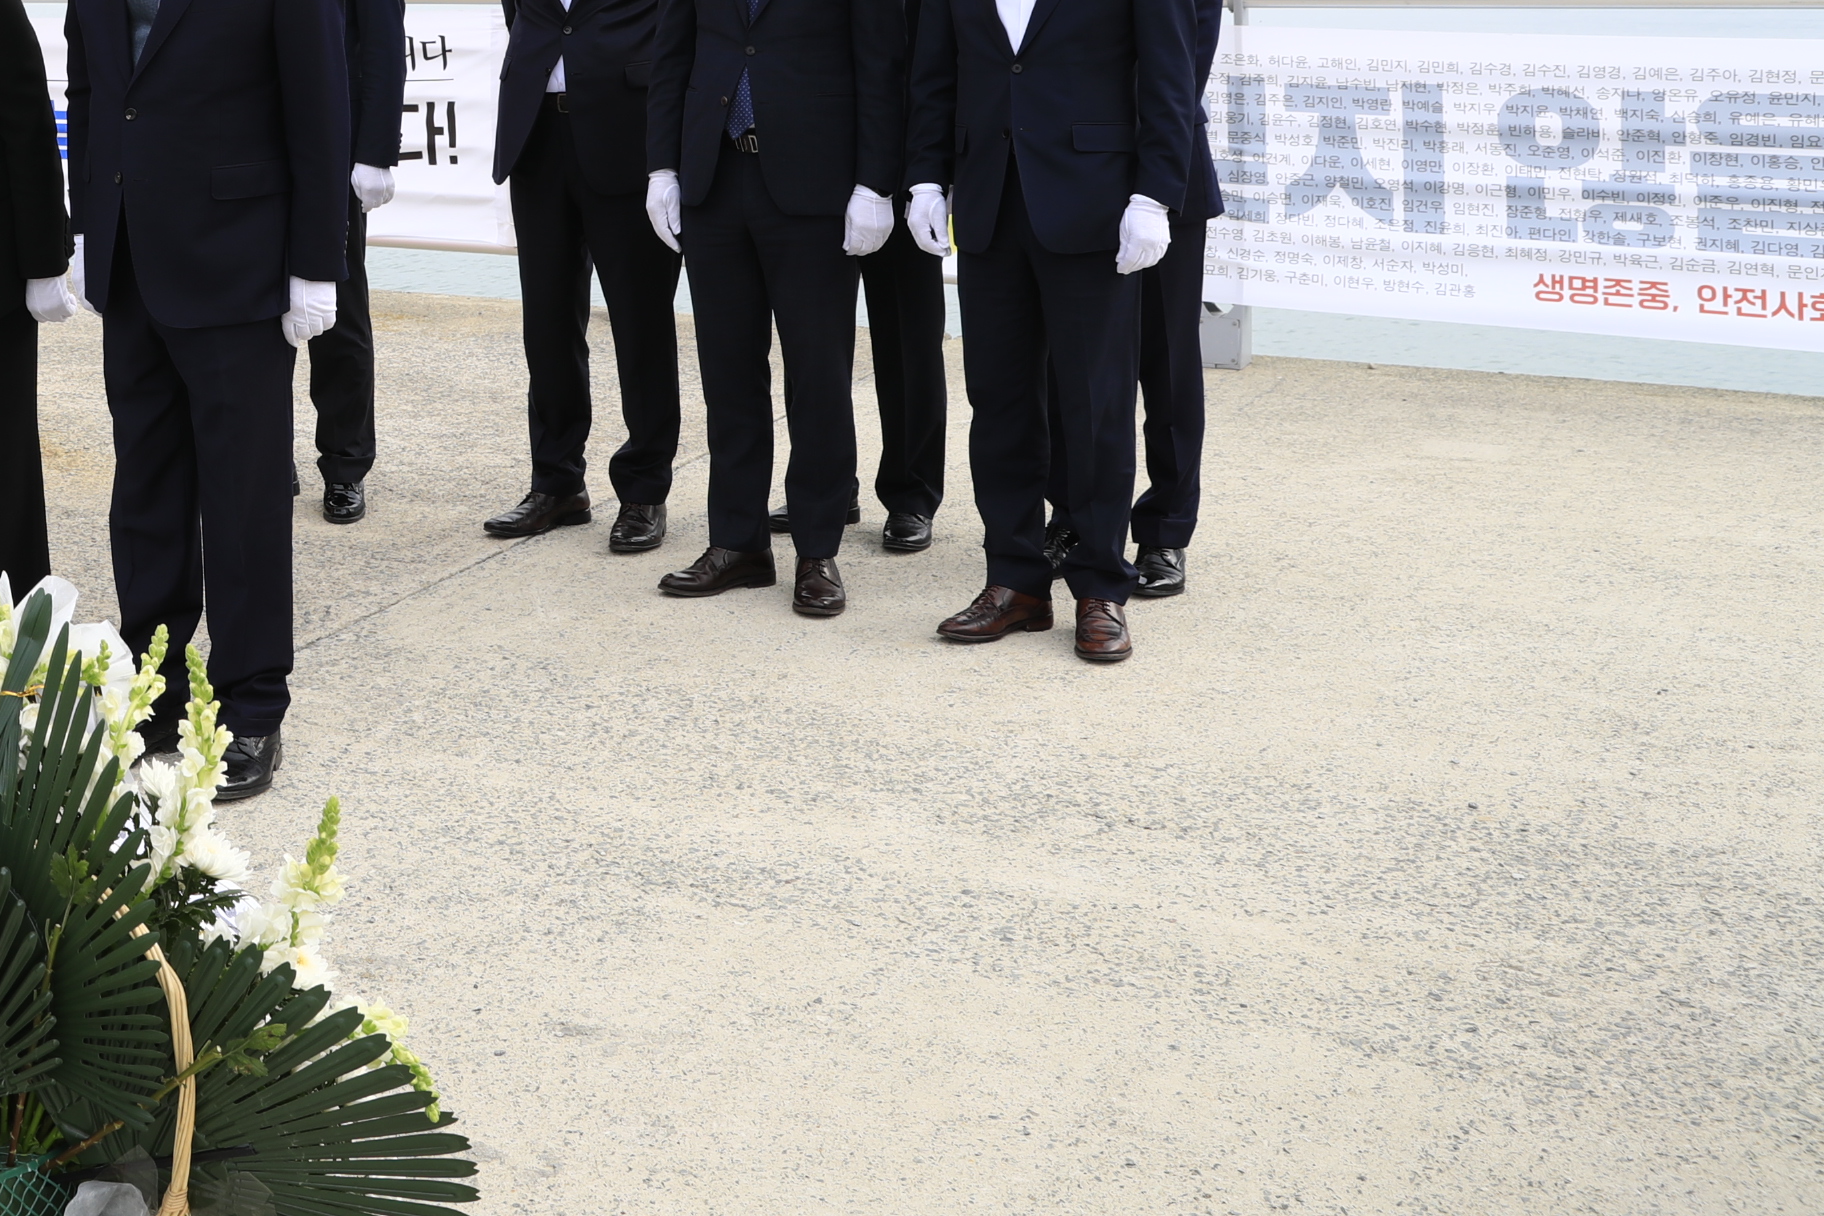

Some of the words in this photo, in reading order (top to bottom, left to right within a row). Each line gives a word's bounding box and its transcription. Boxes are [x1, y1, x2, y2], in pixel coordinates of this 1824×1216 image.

[1219, 51, 1263, 69] 조은화,
[1267, 53, 1311, 71] 허다윤,
[1316, 55, 1361, 73] 고해인,
[1366, 57, 1412, 75] 김민지,
[1416, 59, 1464, 77] 김민희,
[1468, 61, 1517, 78] 김수경,
[1521, 63, 1571, 80] 김수진,
[1576, 64, 1626, 82] 김영경,
[1631, 66, 1683, 83] 김예은,
[1688, 67, 1742, 84] 김주아,
[1747, 69, 1802, 86] 김현정,
[1206, 89, 1250, 107] 김영은,
[1253, 91, 1298, 109] 김주은,
[1302, 93, 1347, 111] 김지인,
[1351, 95, 1397, 113] 박영란,
[1401, 97, 1448, 115] 박예슬,
[1453, 99, 1501, 117] 박지우,
[1505, 101, 1553, 119] 박지윤,
[1613, 106, 1664, 124] 백지숙,
[1670, 108, 1722, 126] 신승희,
[1727, 110, 1781, 128] 유예은,
[1208, 71, 1235, 88] 수정,
[1238, 72, 1283, 90] 김주희,
[1286, 75, 1331, 92] 김지윤,
[1335, 77, 1381, 94] 남수빈,
[1436, 80, 1483, 98] 박정은,
[1488, 82, 1536, 100] 박주희,
[1595, 86, 1646, 103] 송지나,
[1651, 87, 1702, 105] 양온유,
[1707, 89, 1761, 106] 오유정,
[1766, 90, 1821, 108] 윤민지,
[1208, 109, 1254, 127] 김웅기,
[1257, 111, 1301, 129] 김윤수,
[1306, 114, 1351, 132] 김정현,
[1355, 116, 1401, 134] 김호연,
[1405, 118, 1452, 136] 박수현,
[1507, 123, 1556, 141] 빈하용,
[1562, 125, 1611, 143] 슬라바,
[1615, 127, 1666, 145] 안준혁,
[1671, 129, 1723, 147] 안형준,
[1728, 131, 1783, 149] 임경빈,
[1227, 130, 1269, 148] 문중식,
[1273, 132, 1318, 150] 박성호,
[1322, 134, 1367, 152] 박준민,
[1372, 136, 1418, 154] 박진리,
[1422, 138, 1469, 156] 박홍래,
[1474, 141, 1522, 159] 서동진,
[1526, 143, 1575, 161] 오준영,
[1580, 145, 1630, 163] 이석준,
[1635, 148, 1686, 166] 이진환,
[1689, 150, 1744, 168] 이창현,
[1750, 153, 1804, 171] 이홍승,
[1251, 150, 1295, 168] 이건계,
[1300, 152, 1345, 170] 이다운,
[1349, 155, 1395, 173] 이세현,
[1401, 157, 1446, 175] 이영만,
[1451, 159, 1498, 178] 이장환,
[1504, 162, 1551, 180] 이태민,
[1557, 164, 1606, 183] 전현탁,
[1668, 170, 1720, 188] 최덕하,
[1227, 168, 1269, 187] 심장영,
[1274, 171, 1319, 190] 안중근,
[1323, 174, 1368, 192] 양철민,
[1372, 177, 1418, 195] 오영석,
[1423, 179, 1470, 198] 이강명,
[1474, 182, 1522, 200] 이근형,
[1527, 185, 1575, 203] 이민우,
[1581, 187, 1630, 206] 이수빈,
[1635, 190, 1687, 208] 이정인,
[1692, 192, 1744, 211] 이준우,
[1750, 195, 1804, 213] 이진형,
[1301, 192, 1345, 210] 이재욱,
[1351, 195, 1395, 213] 이호진,
[1402, 198, 1446, 216] 임건우,
[1452, 201, 1499, 219] 임현진,
[1504, 203, 1553, 222] 장준형,
[1668, 212, 1720, 231] 조봉석,
[1725, 215, 1779, 234] 조찬민,
[1203, 224, 1247, 243] 전수영,
[1252, 227, 1296, 246] 김초원,
[1300, 231, 1345, 250] 이해봉,
[1350, 234, 1395, 253] 남윤철,
[1401, 238, 1447, 257] 이지혜,
[1451, 241, 1499, 261] 김응현,
[1504, 245, 1552, 264] 최혜정,
[1557, 249, 1607, 268] 강민규,
[1612, 252, 1663, 271] 박육근,
[1668, 256, 1721, 275] 김순금,
[1726, 259, 1780, 278] 김연혁,
[1274, 211, 1318, 230] 정다빈,
[1323, 214, 1368, 232] 정다혜,
[1373, 217, 1419, 235] 조은정,
[1423, 220, 1470, 238] 진윤희,
[1475, 223, 1522, 241] 최진아,
[1527, 226, 1576, 244] 편다인,
[1581, 229, 1631, 248] 강한솔,
[1692, 235, 1746, 254] 권지혜,
[1750, 238, 1804, 257] 김다영,
[1201, 264, 1233, 282] 묘희,
[1236, 266, 1280, 285] 김기웅,
[1283, 269, 1328, 288] 구춘미,
[1333, 272, 1378, 291] 이현우,
[1382, 276, 1429, 295] 방현수,
[1226, 246, 1269, 265] 신경순,
[1273, 249, 1317, 268] 정명숙,
[1322, 252, 1367, 272] 이제창,
[1371, 256, 1417, 275] 서순자,
[1422, 260, 1468, 279] 박성미,
[1533, 273, 1678, 312] 생명존중,
